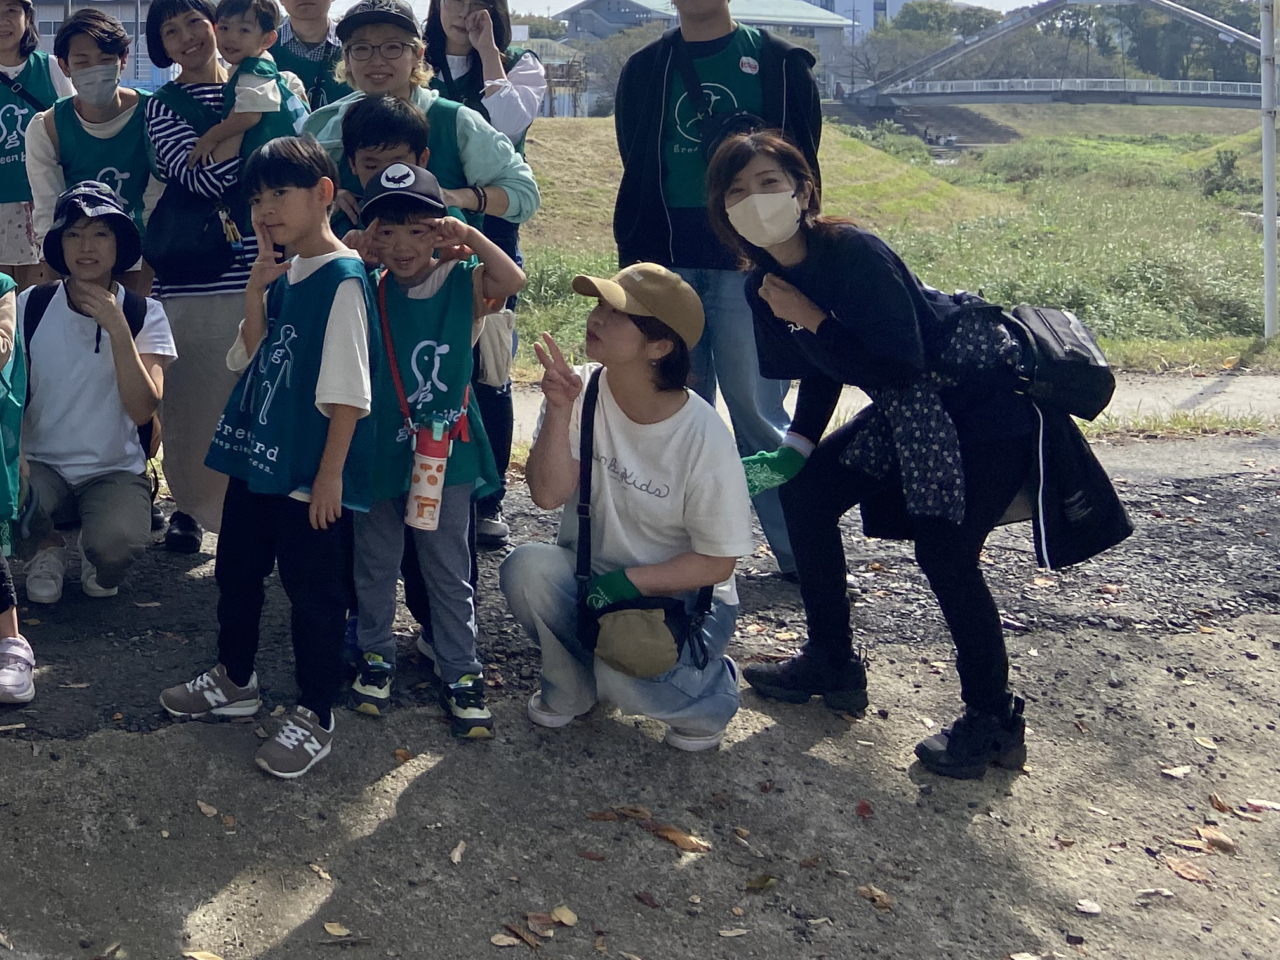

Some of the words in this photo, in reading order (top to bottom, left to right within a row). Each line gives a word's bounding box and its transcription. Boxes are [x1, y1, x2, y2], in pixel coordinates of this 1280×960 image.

[252, 441, 280, 463] rd
[620, 467, 670, 499] Kids
[203, 687, 229, 707] N
[302, 735, 323, 758] N
